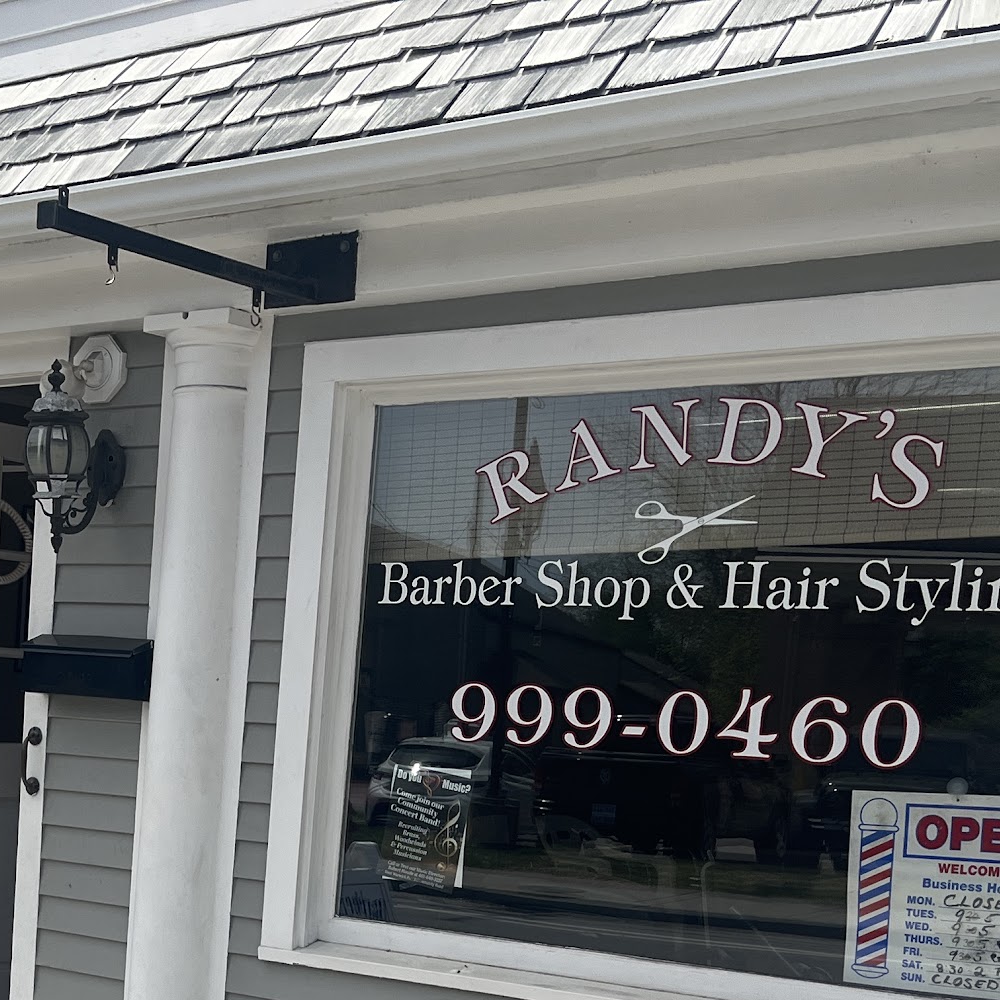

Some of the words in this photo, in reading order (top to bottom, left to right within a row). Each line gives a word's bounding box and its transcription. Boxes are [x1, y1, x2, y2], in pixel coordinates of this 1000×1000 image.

[475, 396, 945, 524] RANDY'S
[378, 561, 523, 607] Barber
[535, 559, 651, 621] Shop
[666, 563, 704, 611] &
[719, 560, 840, 612] Hair
[450, 682, 922, 771] 999-0460
[397, 769, 407, 780] Do
[442, 779, 471, 794] Music?
[396, 787, 416, 801] Come
[415, 795, 430, 806] join
[431, 801, 445, 811] our
[397, 797, 438, 818] Community
[390, 803, 419, 820] Concert
[419, 813, 441, 827] Band!
[915, 814, 1000, 853] OPE
[922, 877, 983, 892] Business
[906, 895, 935, 906] MON.
[906, 908, 937, 919] TUES.
[905, 921, 932, 932] WED.
[904, 934, 943, 946] THURS.
[903, 946, 922, 957] FRI.
[902, 959, 923, 970] SAT.
[900, 972, 925, 984] SUN.
[931, 974, 999, 990] CLOSED
